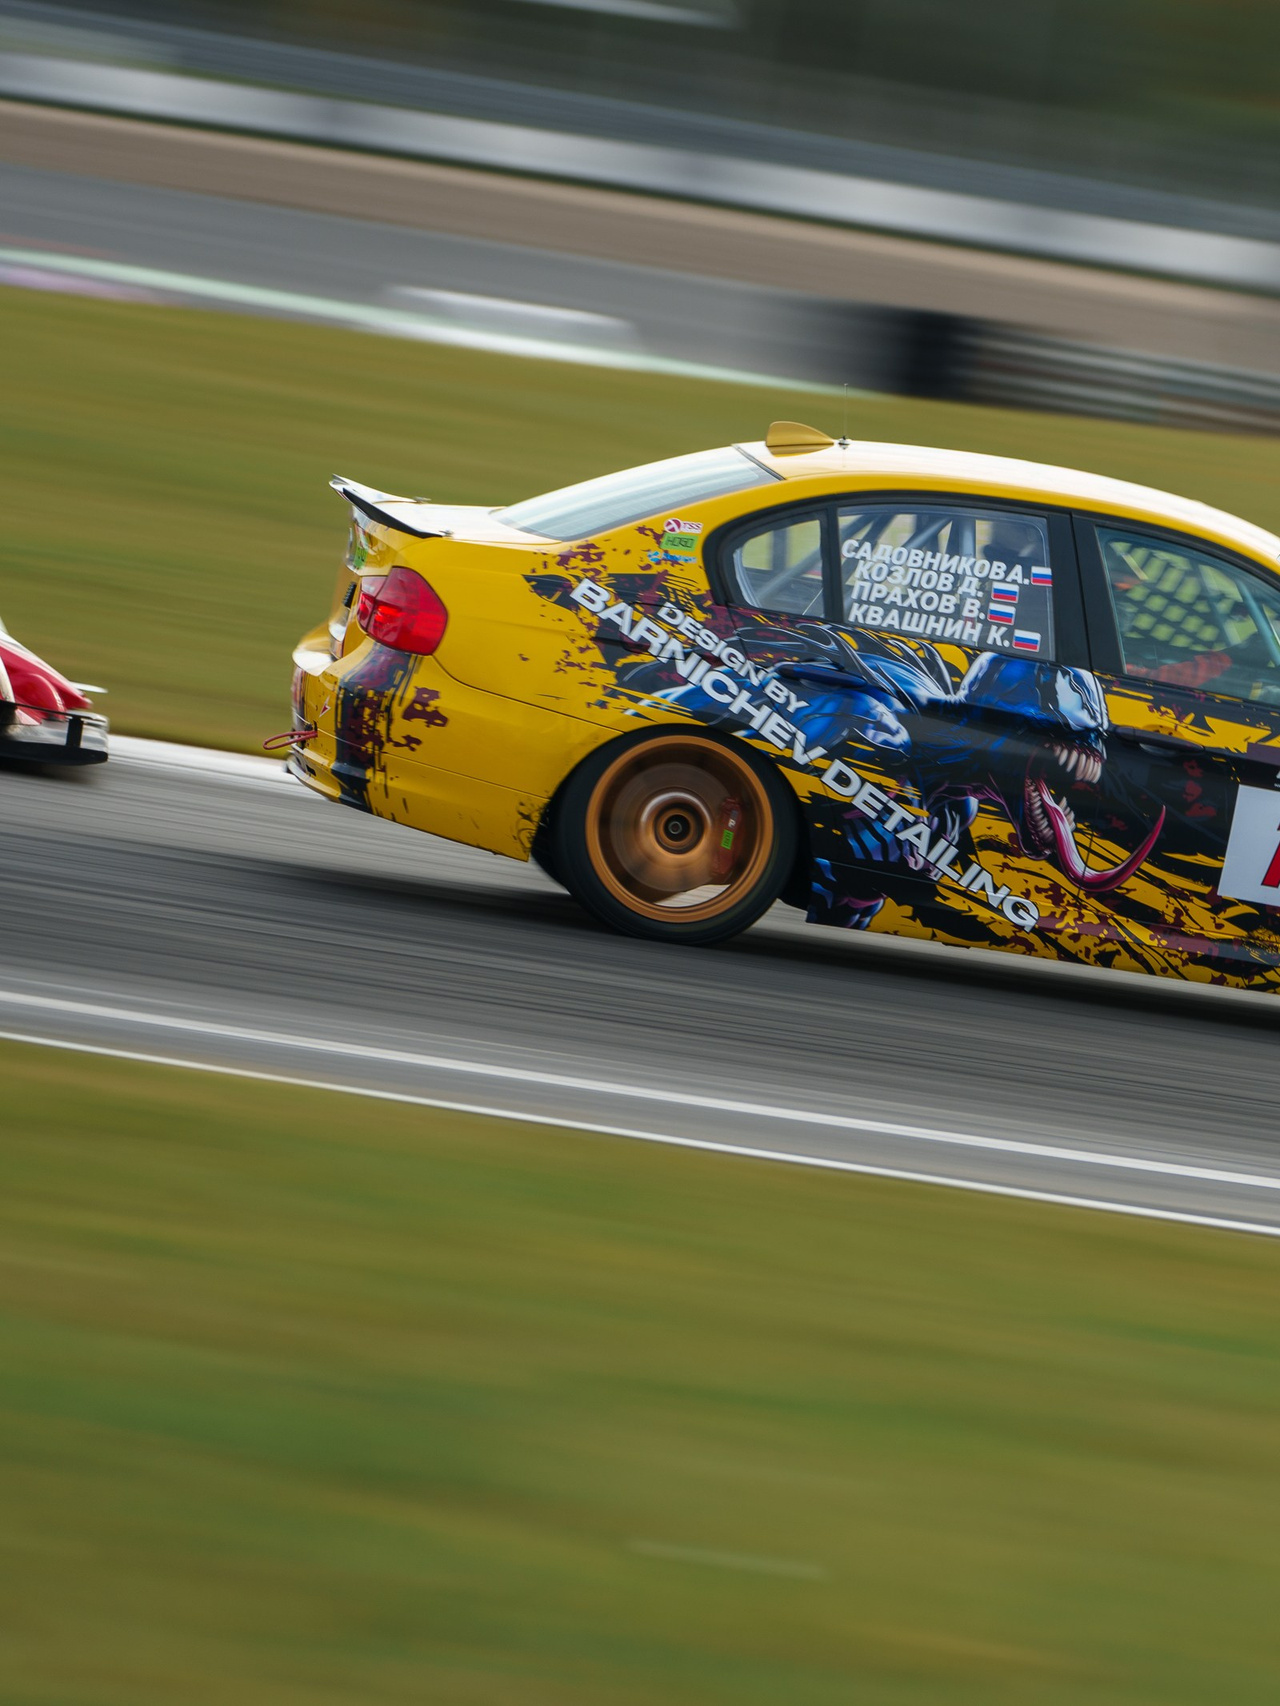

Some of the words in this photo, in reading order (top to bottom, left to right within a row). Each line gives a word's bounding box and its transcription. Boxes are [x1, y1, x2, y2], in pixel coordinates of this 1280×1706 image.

[850, 580, 958, 615] ПРАХОВ
[962, 598, 986, 620] В.
[854, 560, 954, 592] КОЗЛОВ
[957, 576, 984, 598] Д.
[848, 602, 982, 643] КВАШНИН
[987, 625, 1010, 647] К.
[656, 602, 768, 686] DESIGN
[764, 673, 809, 713] BY
[569, 578, 828, 767] BARNICHEV
[820, 758, 1040, 932] DETAILING
